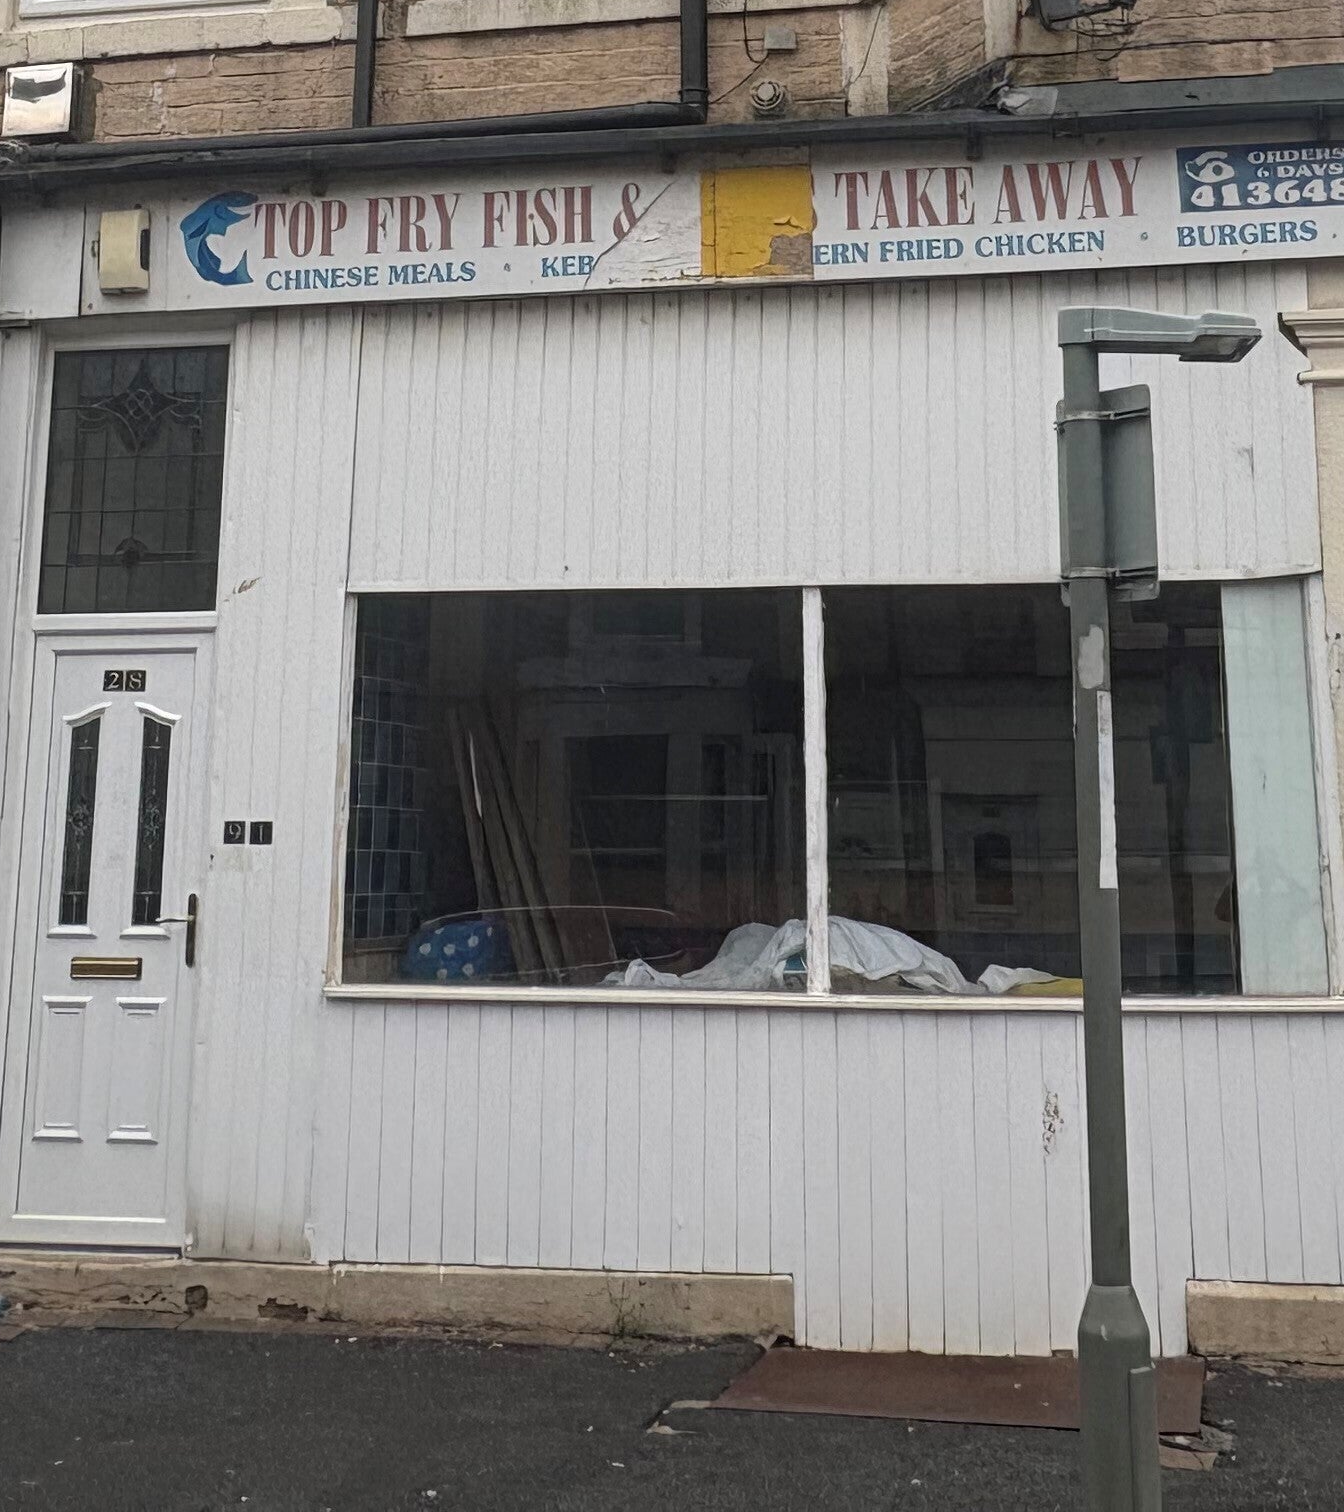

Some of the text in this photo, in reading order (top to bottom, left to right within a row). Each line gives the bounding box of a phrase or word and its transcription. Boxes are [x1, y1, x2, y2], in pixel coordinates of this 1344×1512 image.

[1277, 163, 1343, 178] DAYS
[255, 156, 1143, 259] TOP FRY FISH & TAKE AWAY
[266, 220, 1318, 291] CHINESE MEALS KEB ERN FRIED CHICKEN BURGERS
[106, 671, 143, 690] 28
